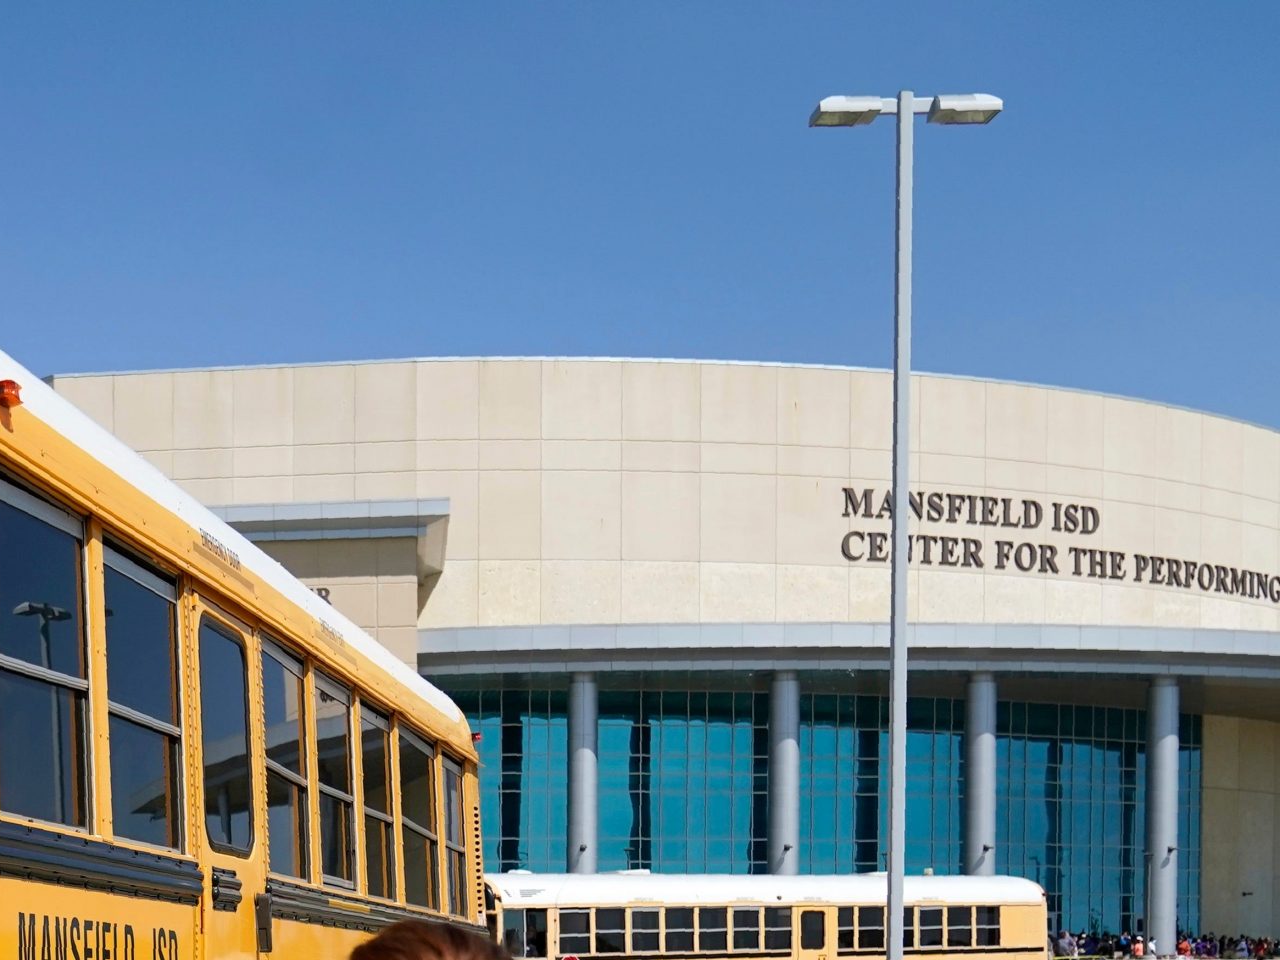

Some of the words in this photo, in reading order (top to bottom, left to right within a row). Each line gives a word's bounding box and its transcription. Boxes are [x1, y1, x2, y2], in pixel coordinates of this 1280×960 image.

[841, 487, 1043, 530] MANSFIELD
[1051, 502, 1100, 535] ISD
[995, 540, 1059, 574] FOR
[1069, 547, 1126, 580] THE
[1133, 554, 1280, 603] PERFORMING
